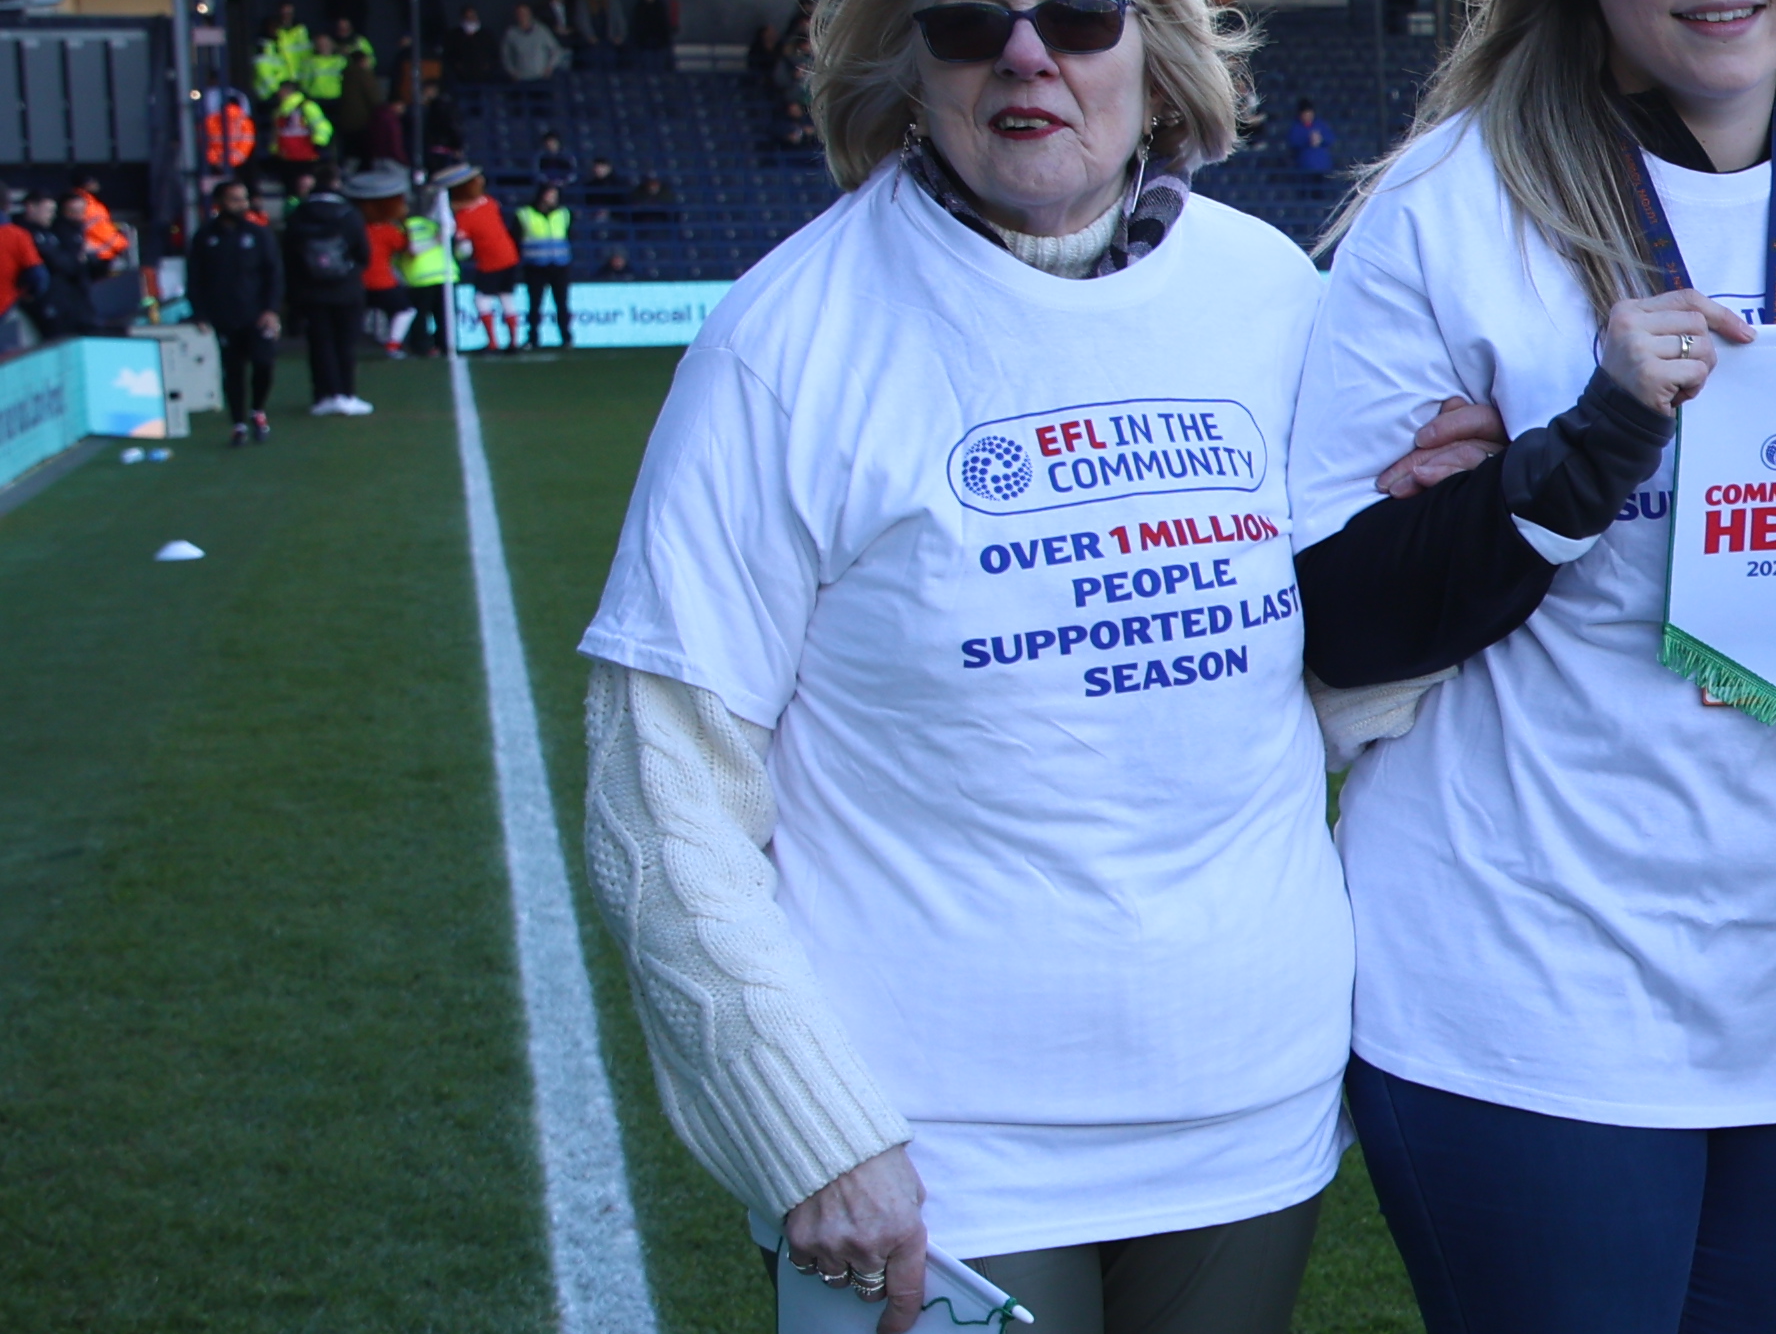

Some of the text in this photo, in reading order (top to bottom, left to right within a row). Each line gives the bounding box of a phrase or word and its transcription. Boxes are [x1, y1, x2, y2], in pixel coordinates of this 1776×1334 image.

[630, 304, 691, 324] local
[1035, 413, 1223, 457] EFL IN THE
[1047, 447, 1254, 493] COMMUNITY
[980, 513, 1279, 575] OVER 1 MILLION
[1072, 558, 1238, 608] PEOPLE
[961, 582, 1300, 669] SUPPORTED LAST
[1083, 644, 1248, 698] SEASON
